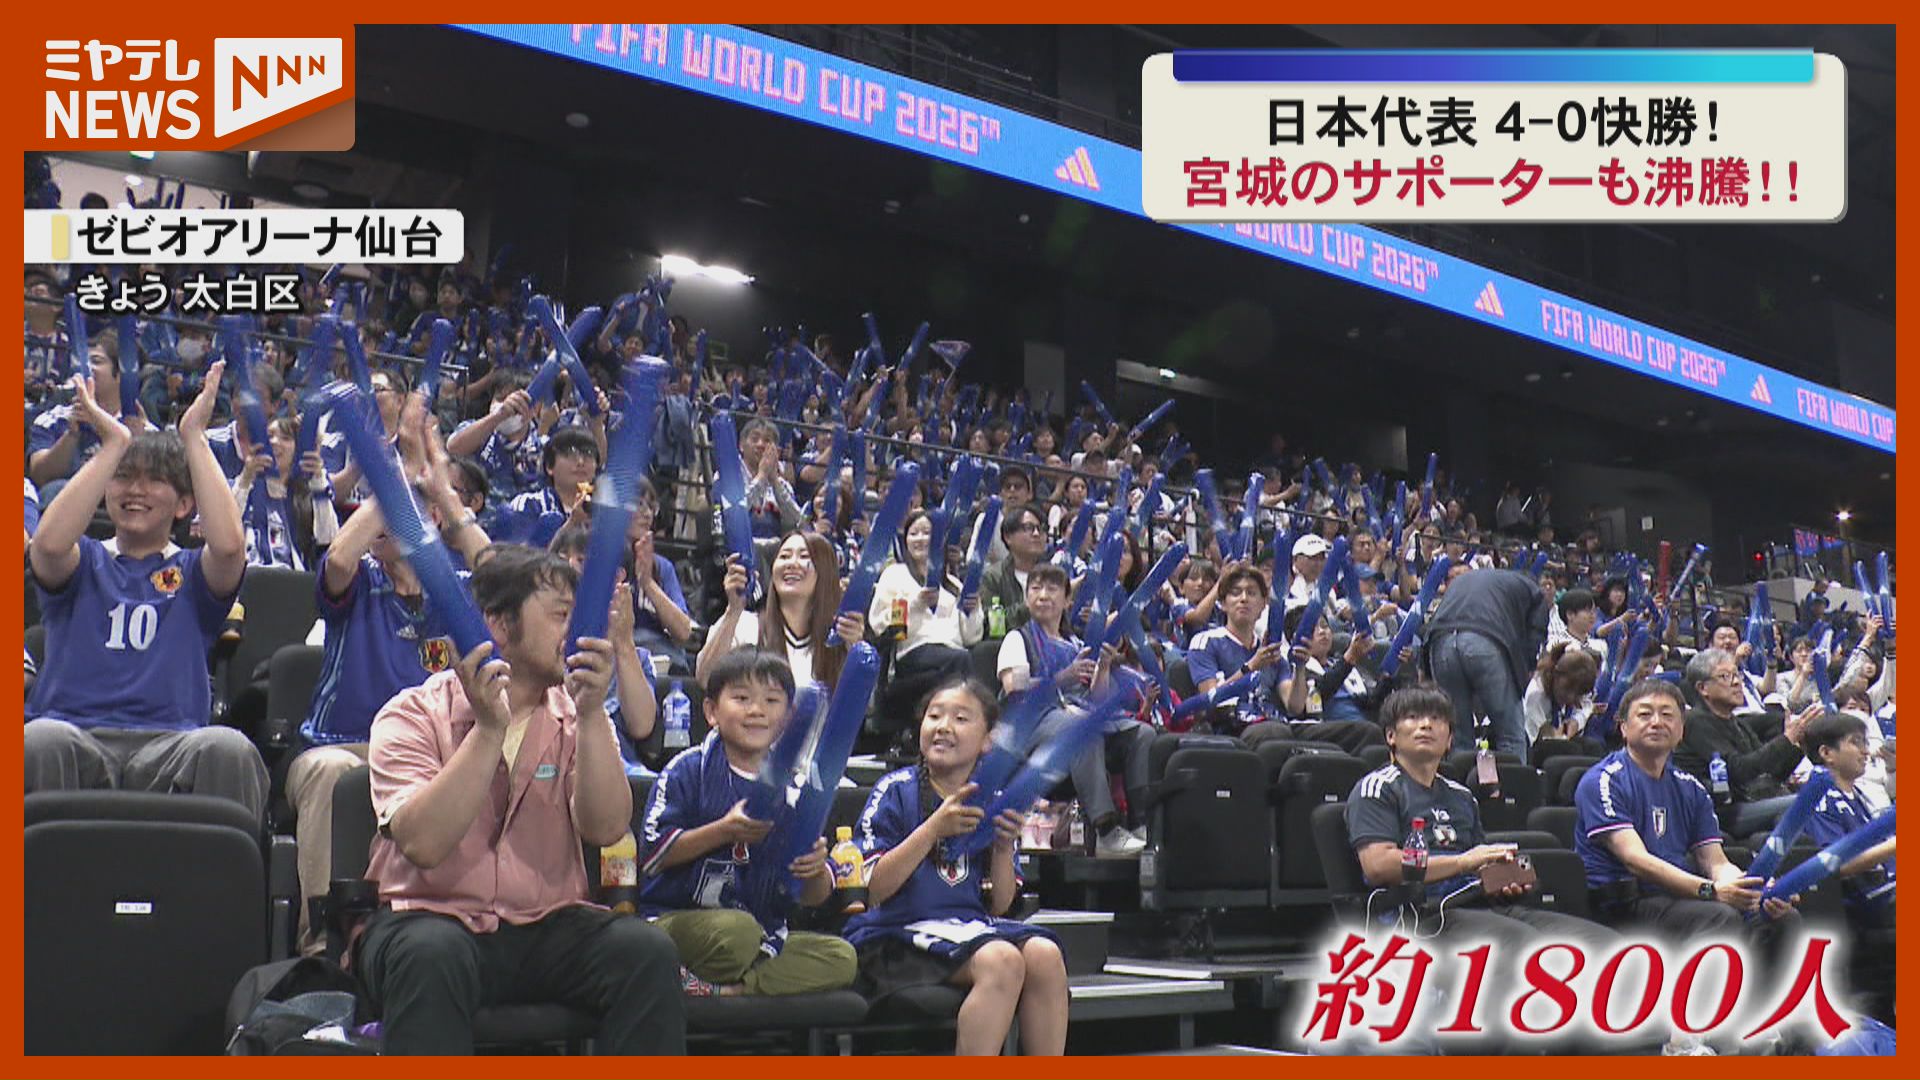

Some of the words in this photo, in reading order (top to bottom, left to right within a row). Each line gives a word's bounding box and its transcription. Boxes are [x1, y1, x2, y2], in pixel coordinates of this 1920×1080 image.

[682, 29, 807, 105] WORLD
[819, 69, 887, 125] CUP
[1321, 225, 1366, 271] CUP
[1540, 299, 1585, 344] FIFA
[1589, 314, 1644, 364] WORLD
[1646, 336, 1677, 373] CUP
[1796, 387, 1829, 421] FIFA
[1830, 399, 1870, 436] WORLD
[1871, 413, 1894, 443] CUP
[105, 602, 158, 650] 10
